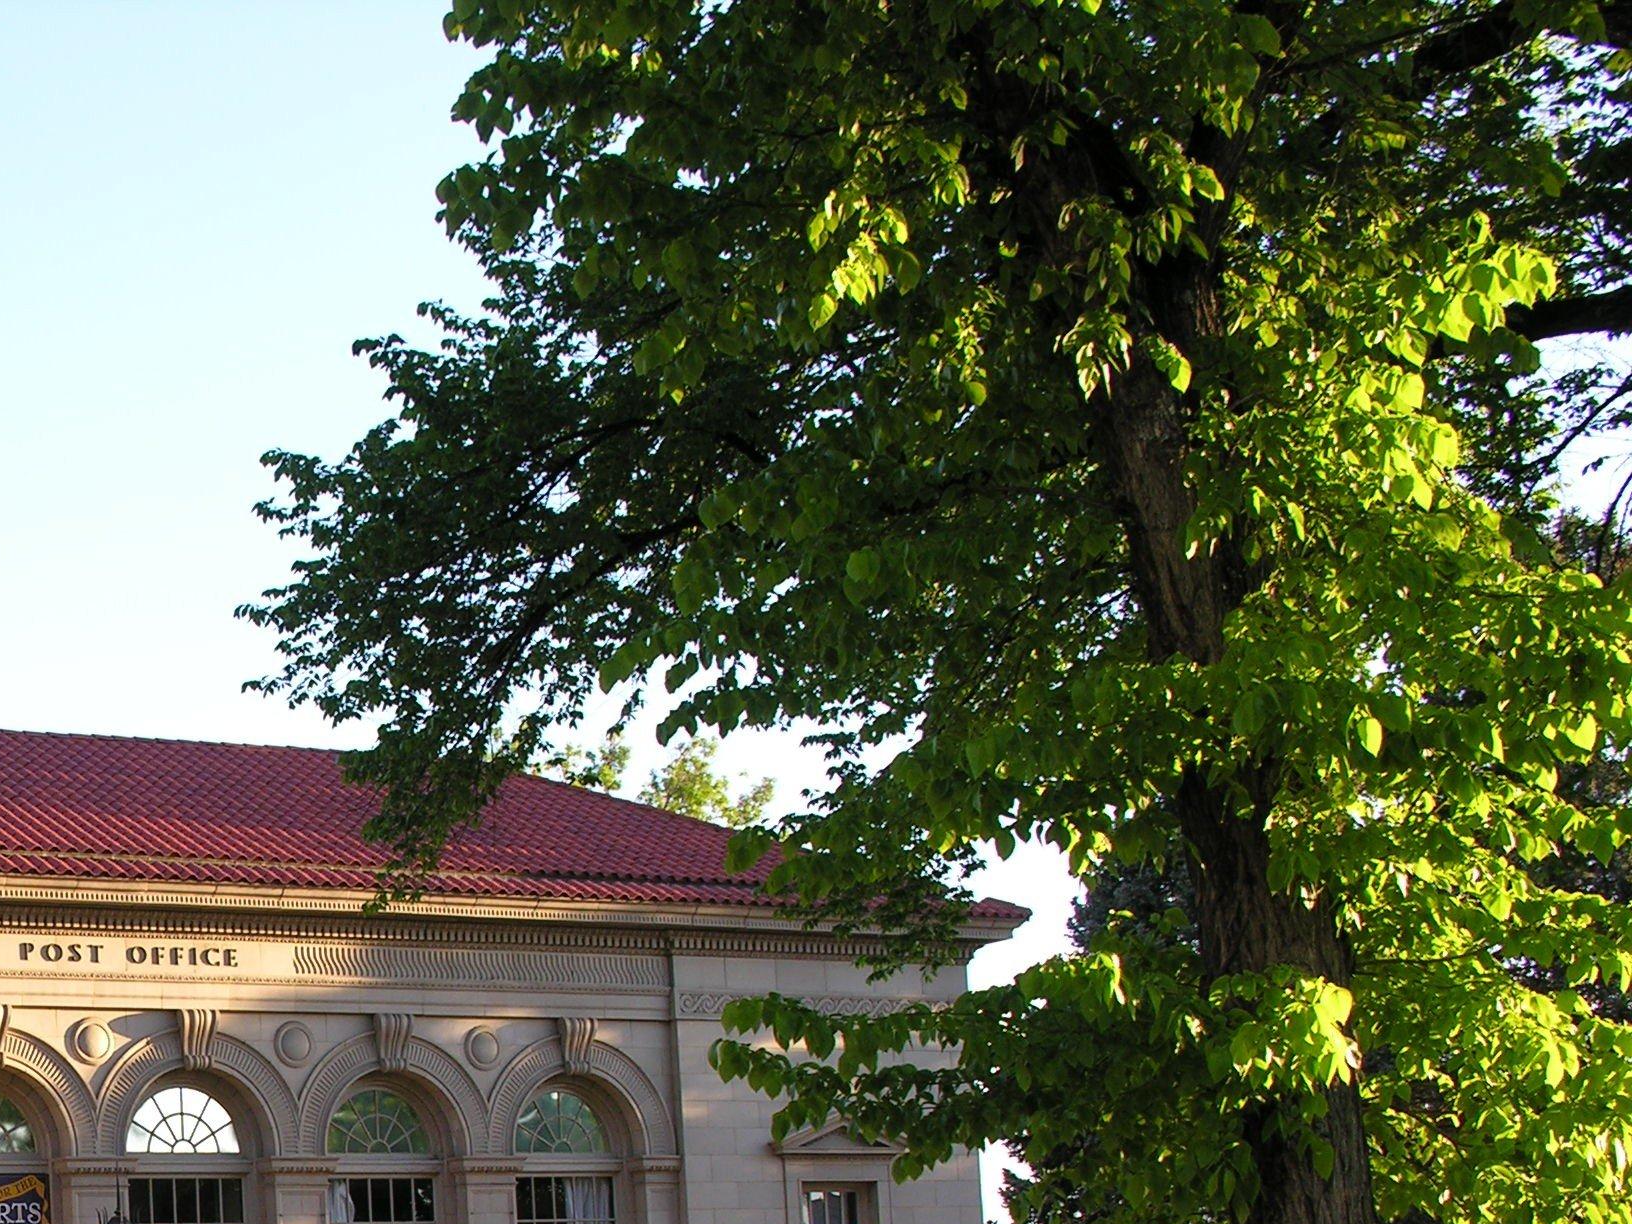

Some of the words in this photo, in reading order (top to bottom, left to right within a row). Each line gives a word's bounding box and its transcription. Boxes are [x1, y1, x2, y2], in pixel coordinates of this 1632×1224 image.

[18, 941, 104, 964] POST
[125, 945, 239, 968] OFFICE
[15, 1176, 38, 1194] THE
